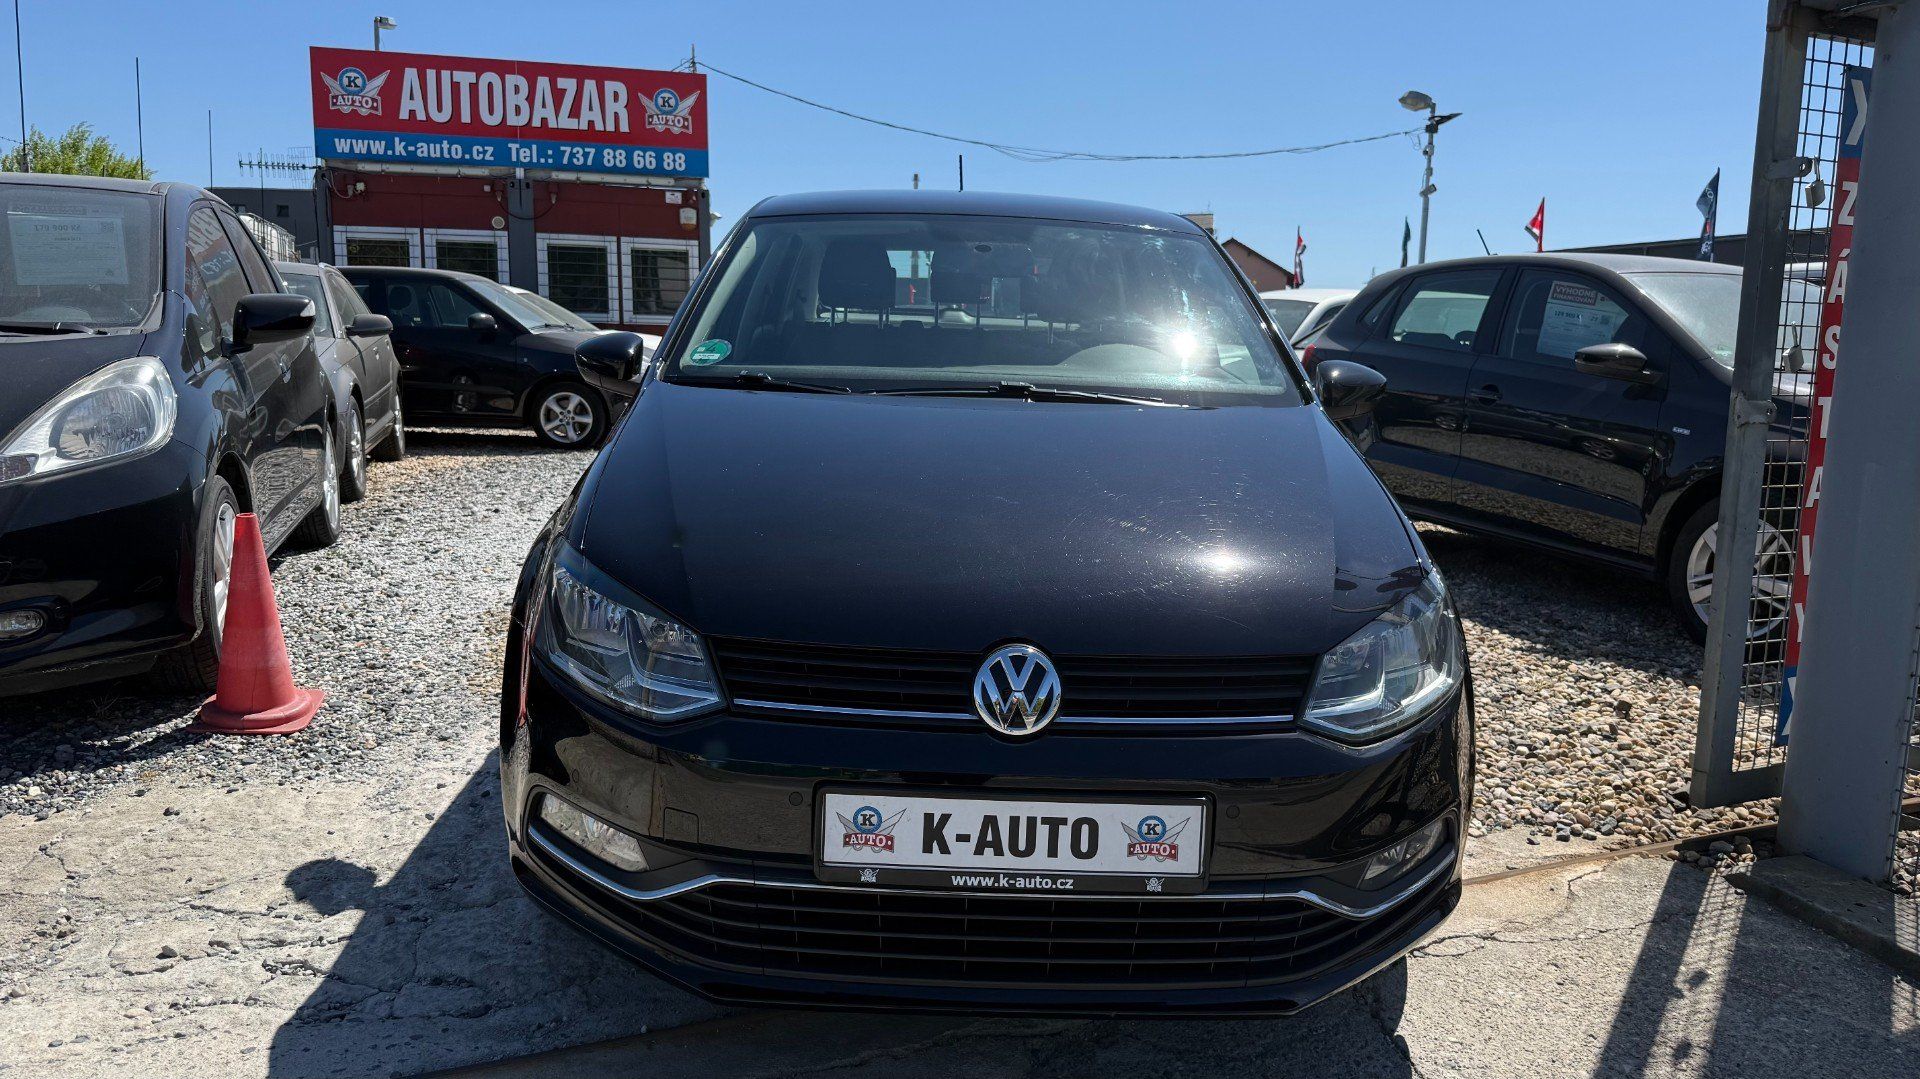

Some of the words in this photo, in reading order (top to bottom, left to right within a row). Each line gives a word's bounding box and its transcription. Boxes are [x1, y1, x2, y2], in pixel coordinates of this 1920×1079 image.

[345, 75, 360, 88] K
[336, 95, 373, 109] AUTO
[399, 67, 630, 133] AUTOBAZAR
[660, 96, 673, 108] K
[652, 114, 684, 128] AUTO
[334, 137, 495, 161] www.k-auto.cz
[508, 143, 553, 164] Tel.:
[560, 146, 596, 166] 737
[603, 148, 627, 168] 88
[633, 150, 657, 170] 66
[663, 152, 687, 172] 88
[1555, 286, 1596, 298] VYHODNÉ
[860, 813, 875, 826] K
[1145, 823, 1160, 835] K
[850, 834, 887, 847] AUTO
[921, 812, 1099, 860] K-AUTO
[1133, 843, 1170, 856] AUTO
[951, 873, 1074, 889] www.k-auto.cz
